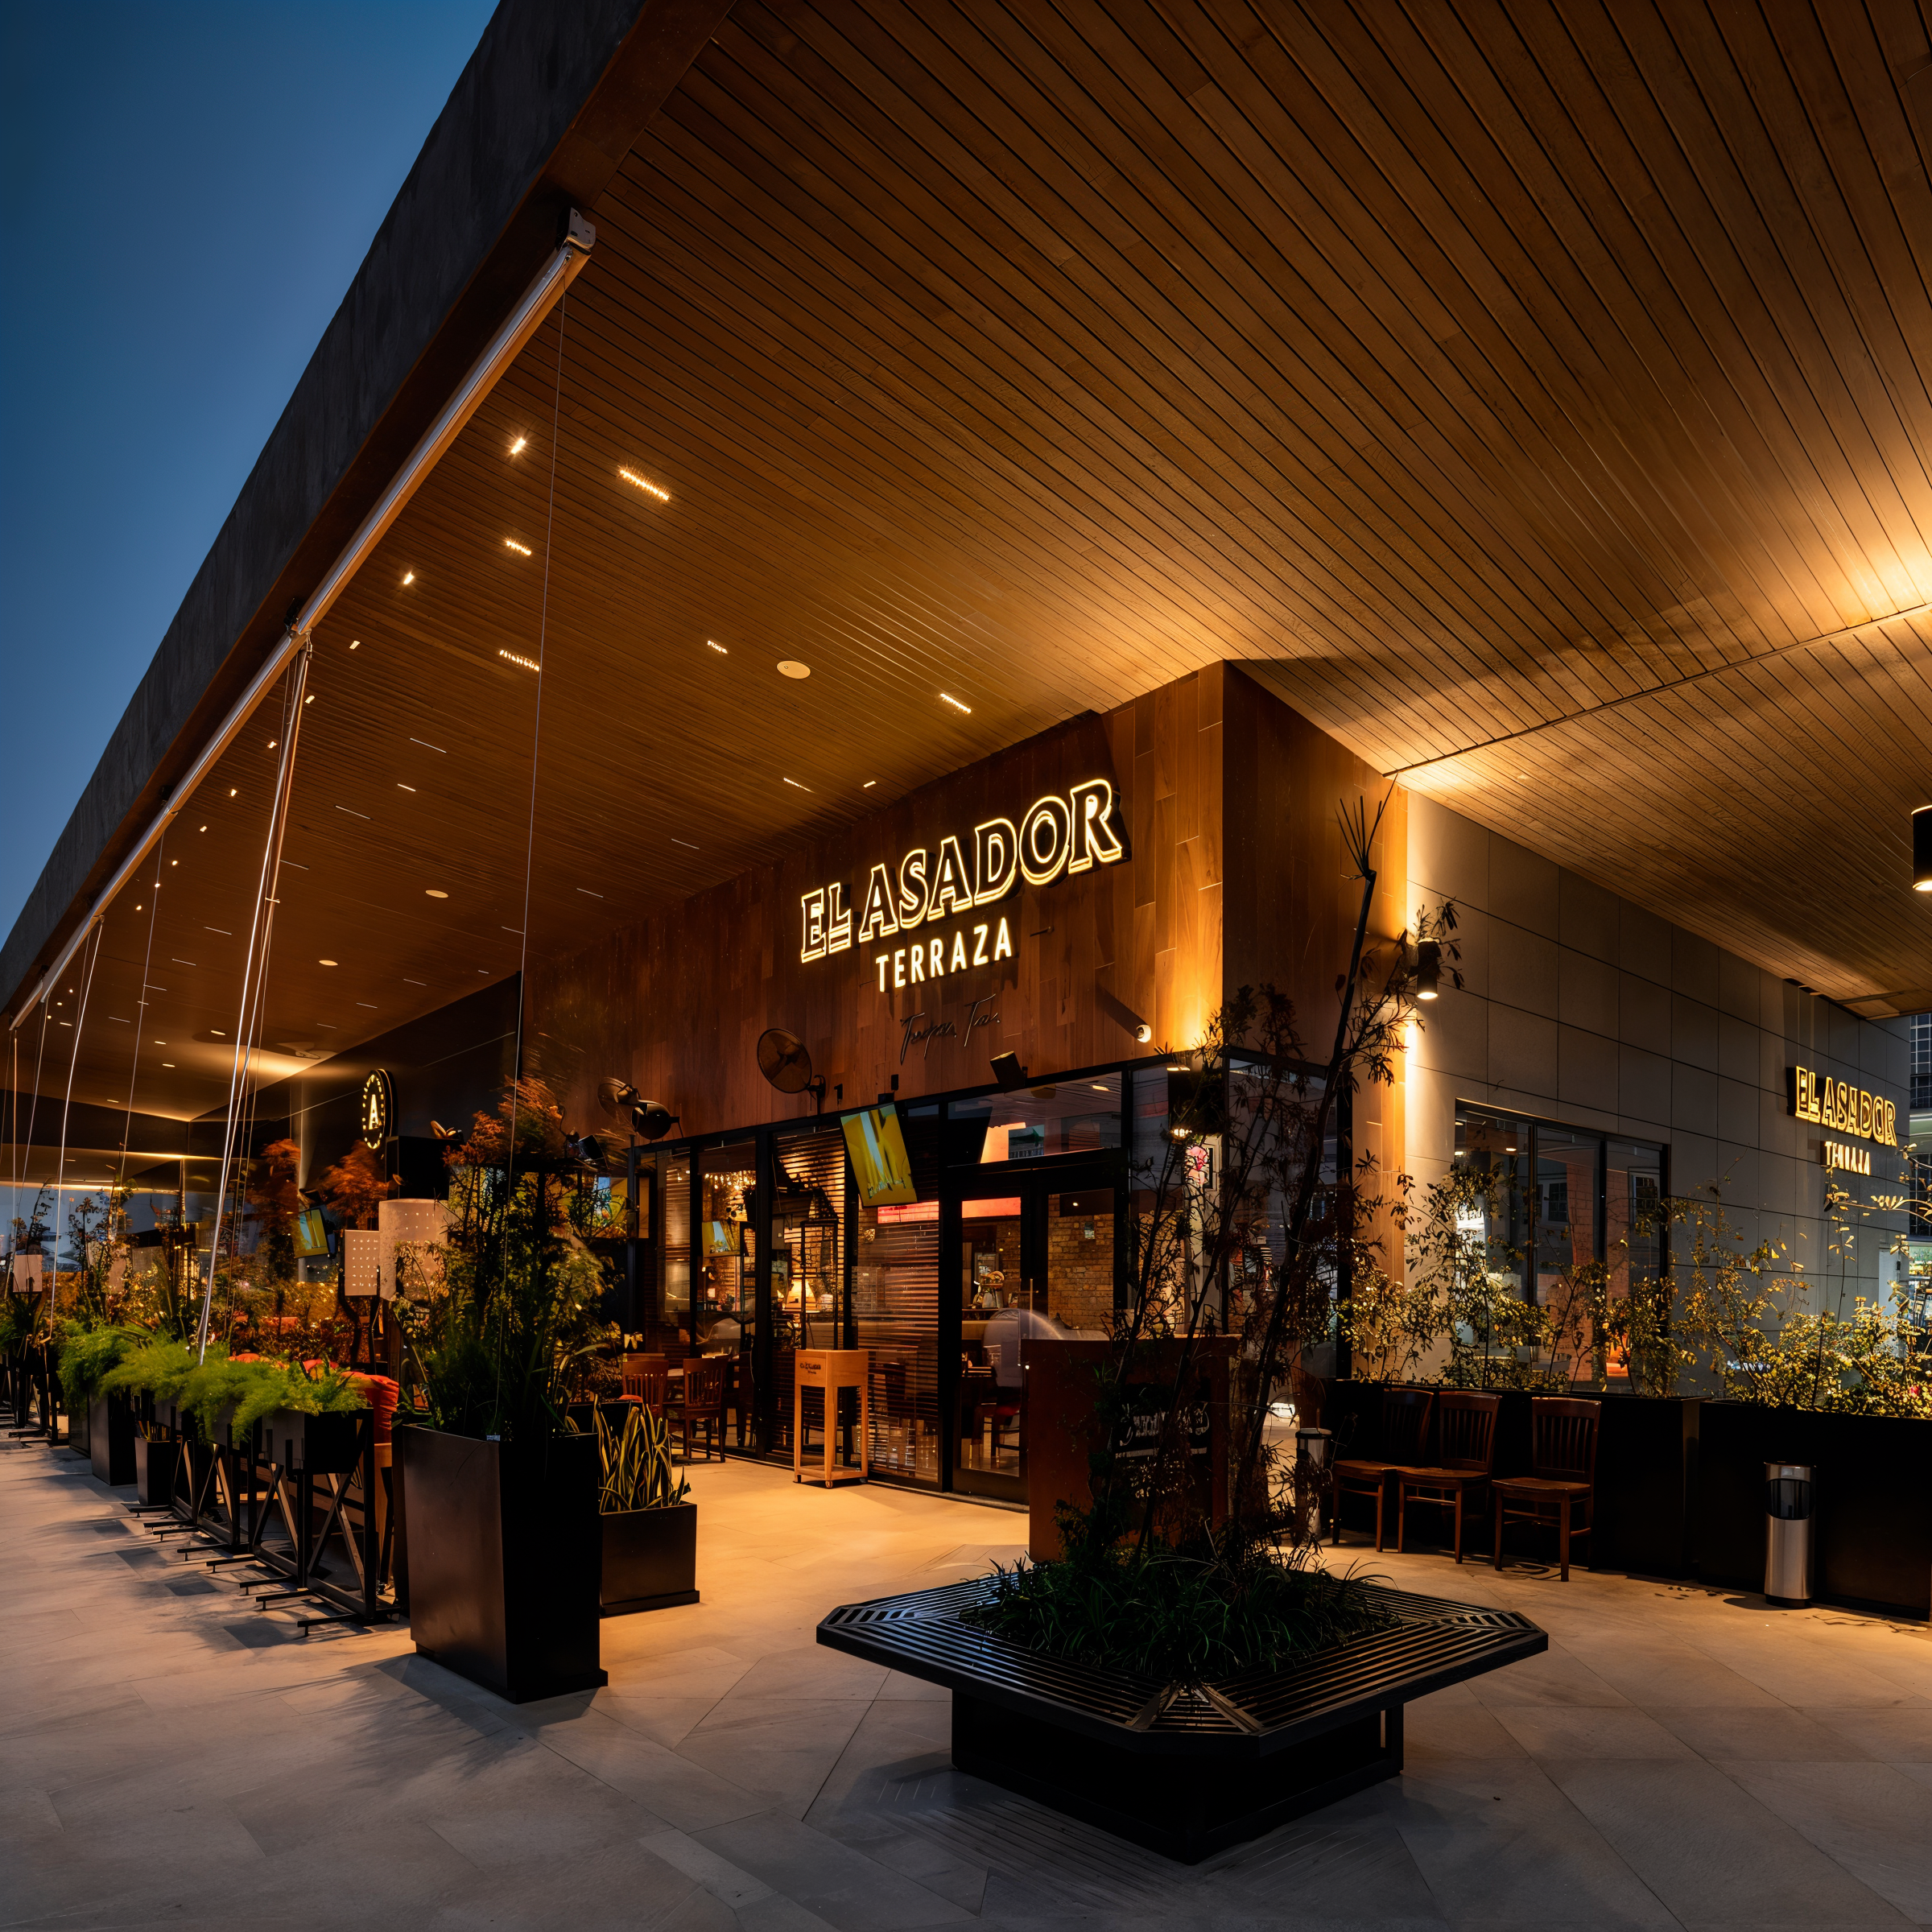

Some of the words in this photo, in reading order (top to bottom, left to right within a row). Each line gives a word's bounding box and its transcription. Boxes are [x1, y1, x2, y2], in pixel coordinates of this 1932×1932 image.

[801, 882, 852, 964] EL
[858, 778, 1123, 943] ASADOR
[875, 917, 1013, 993] TERRAZA
[1795, 1065, 1821, 1124] EL
[1821, 1076, 1897, 1147] ASADOR
